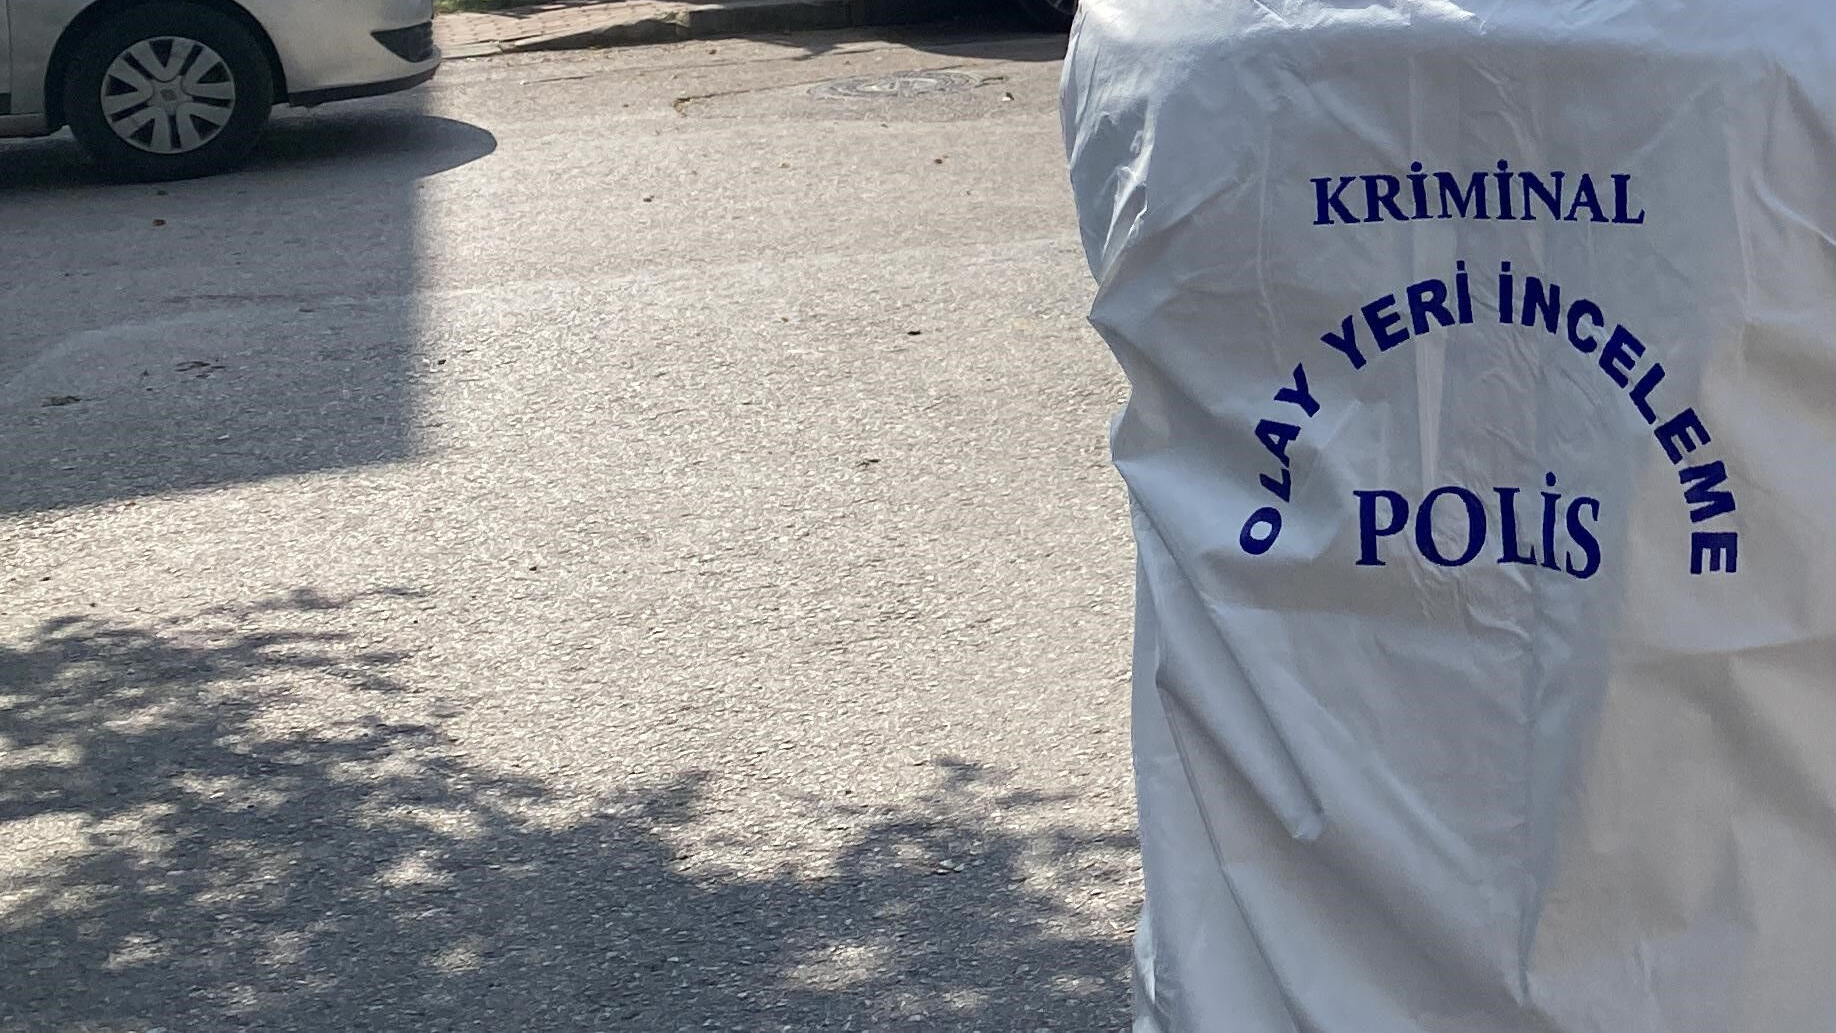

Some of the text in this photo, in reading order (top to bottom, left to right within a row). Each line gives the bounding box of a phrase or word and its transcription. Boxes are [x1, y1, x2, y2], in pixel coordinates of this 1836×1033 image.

[1310, 159, 1646, 226] KRİMİNAL
[1239, 260, 1739, 576] OLAY YERİ İNCELEME
[1353, 471, 1602, 580] POLİS
